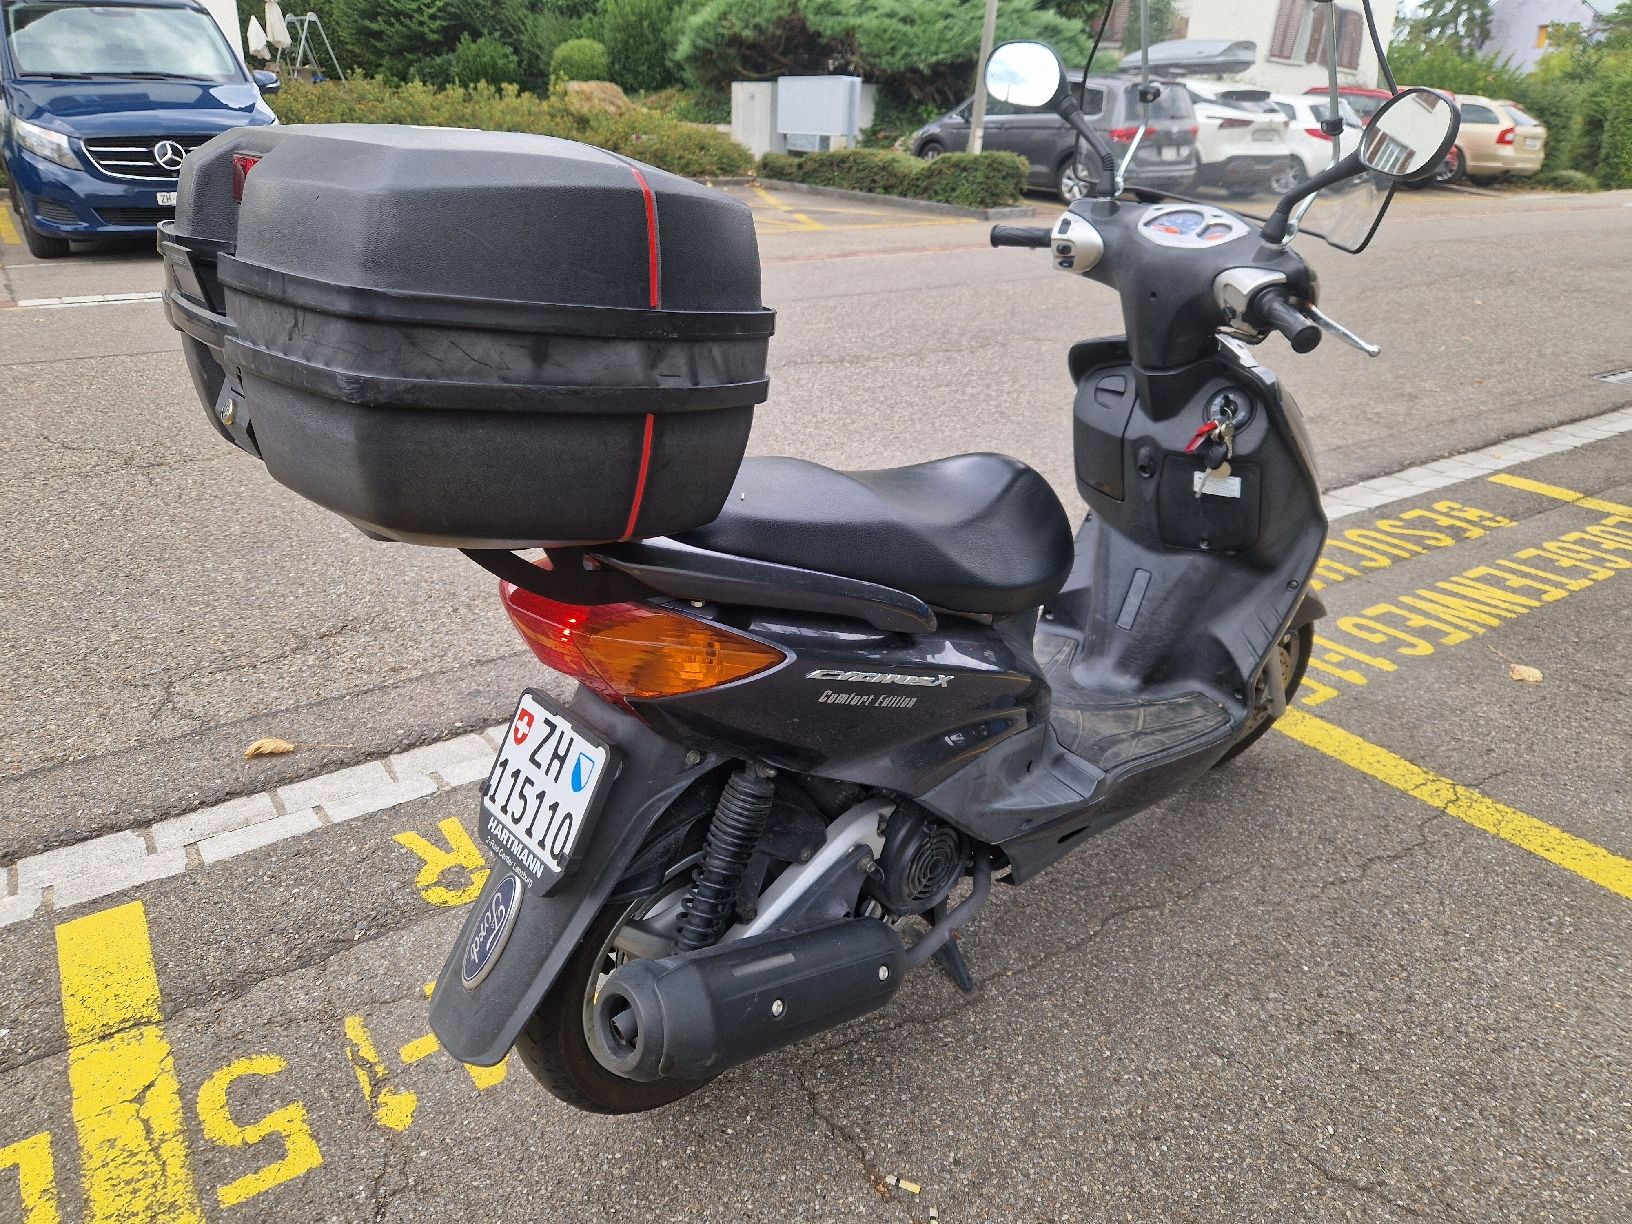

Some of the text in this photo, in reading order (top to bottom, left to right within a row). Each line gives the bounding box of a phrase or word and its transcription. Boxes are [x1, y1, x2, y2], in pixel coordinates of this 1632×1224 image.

[161, 194, 172, 204] ZH
[1310, 501, 1519, 591] BESUCH
[817, 690, 918, 708] Comfort Edition
[529, 717, 574, 783] ZH
[489, 757, 573, 861] 115110
[487, 816, 545, 879] HARTMANN
[470, 892, 505, 963] Ford
